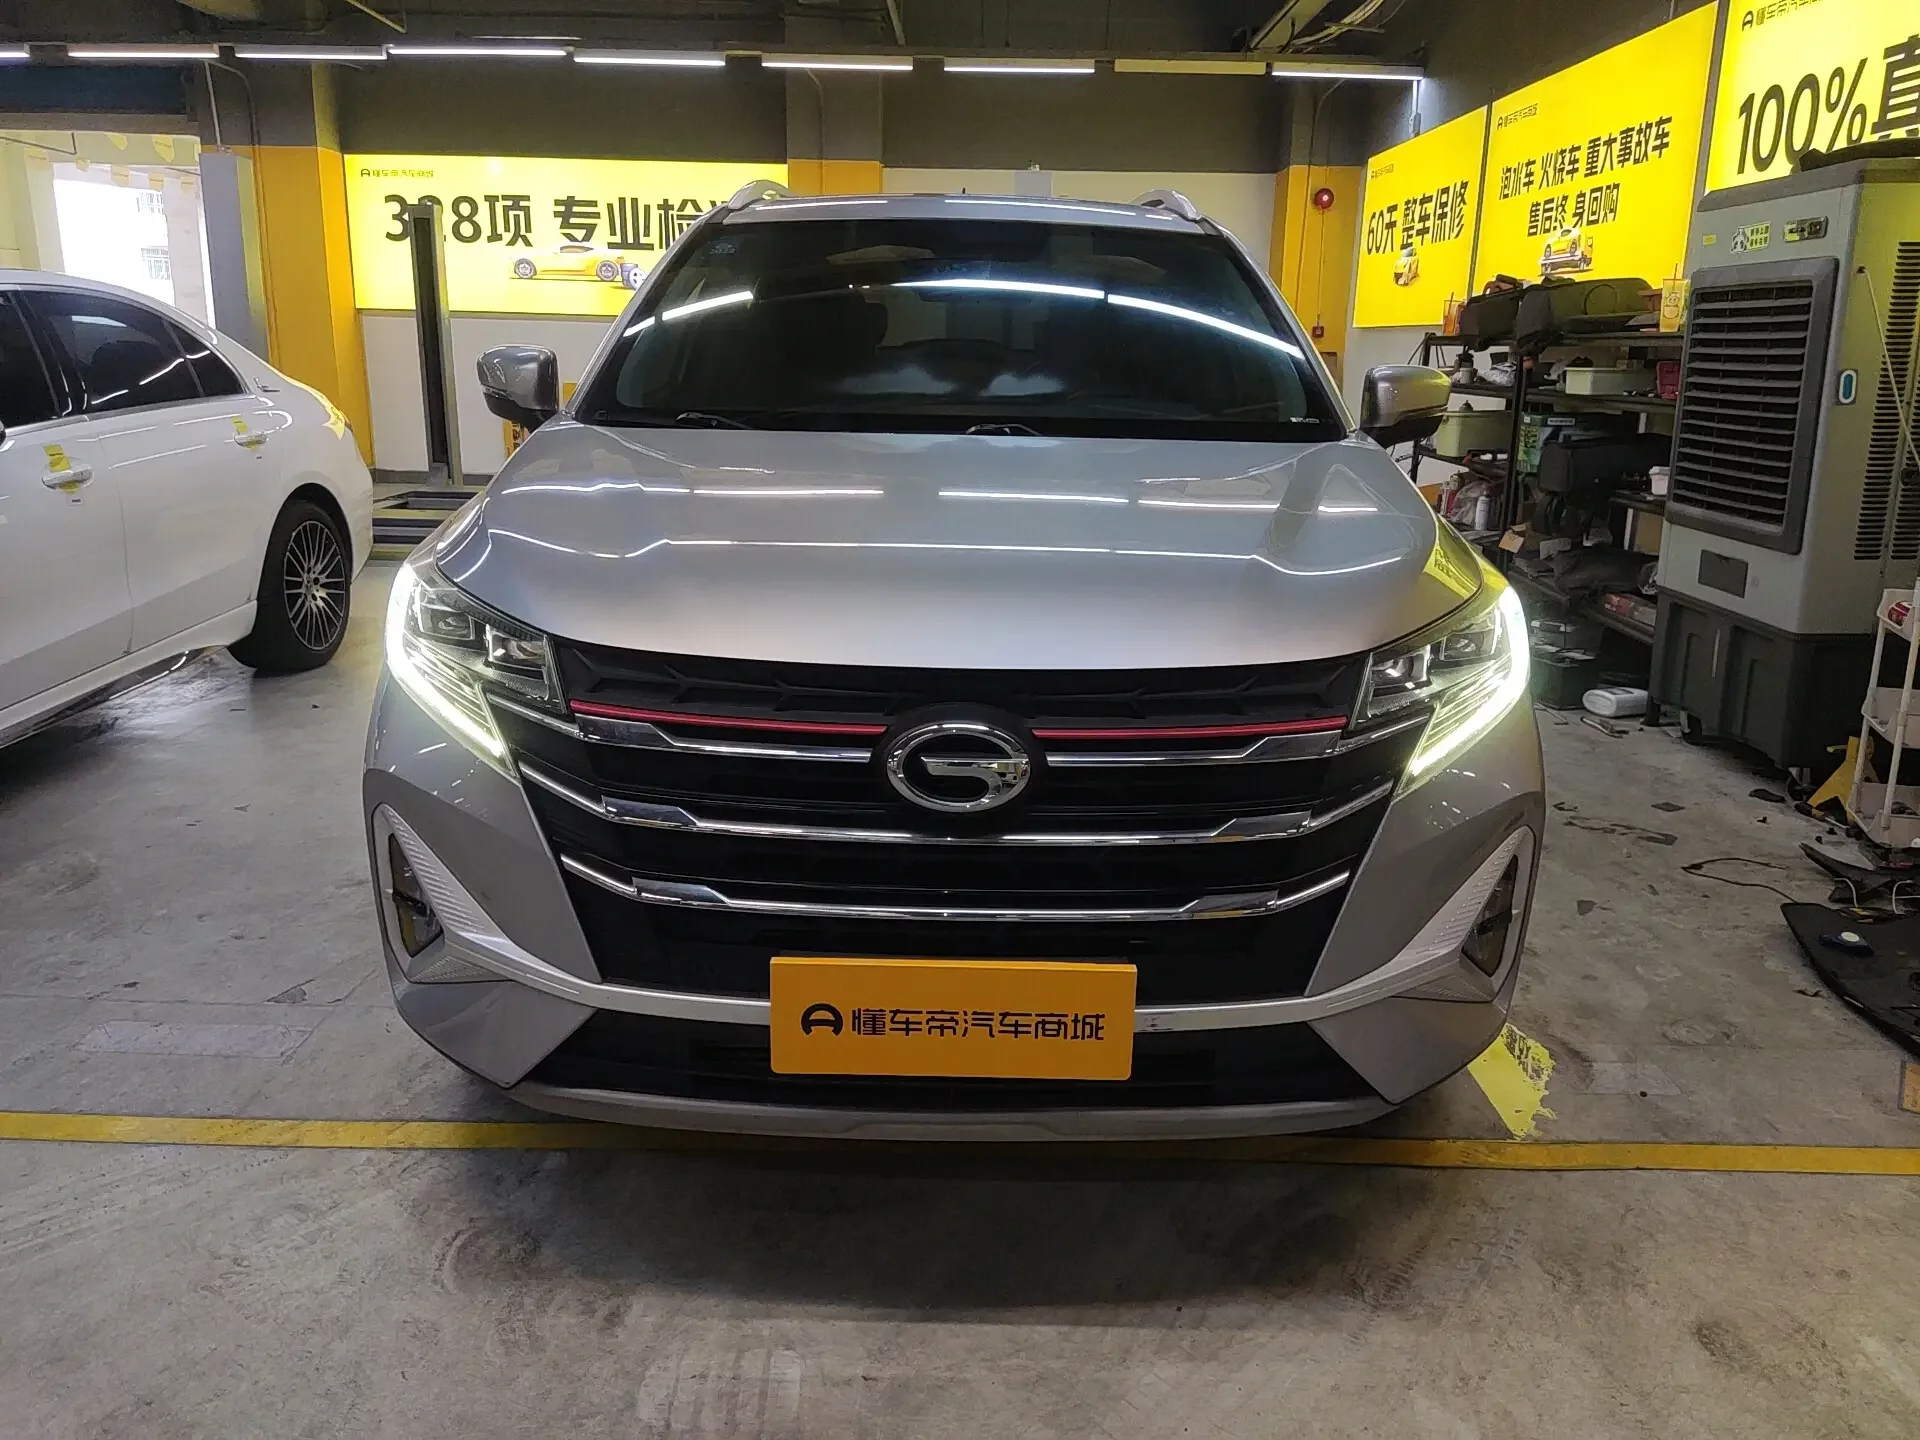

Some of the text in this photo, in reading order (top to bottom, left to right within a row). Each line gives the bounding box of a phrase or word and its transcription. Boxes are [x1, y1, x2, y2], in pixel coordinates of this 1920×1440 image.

[1499, 116, 1673, 200] 泡水车 火烧车 重大事故车
[553, 195, 729, 251] 专业检
[1367, 180, 1469, 256] 60天 整车保修
[1527, 183, 1621, 237] 售后终 身回购
[852, 1007, 1106, 1041] 懂车帝汽车商城
